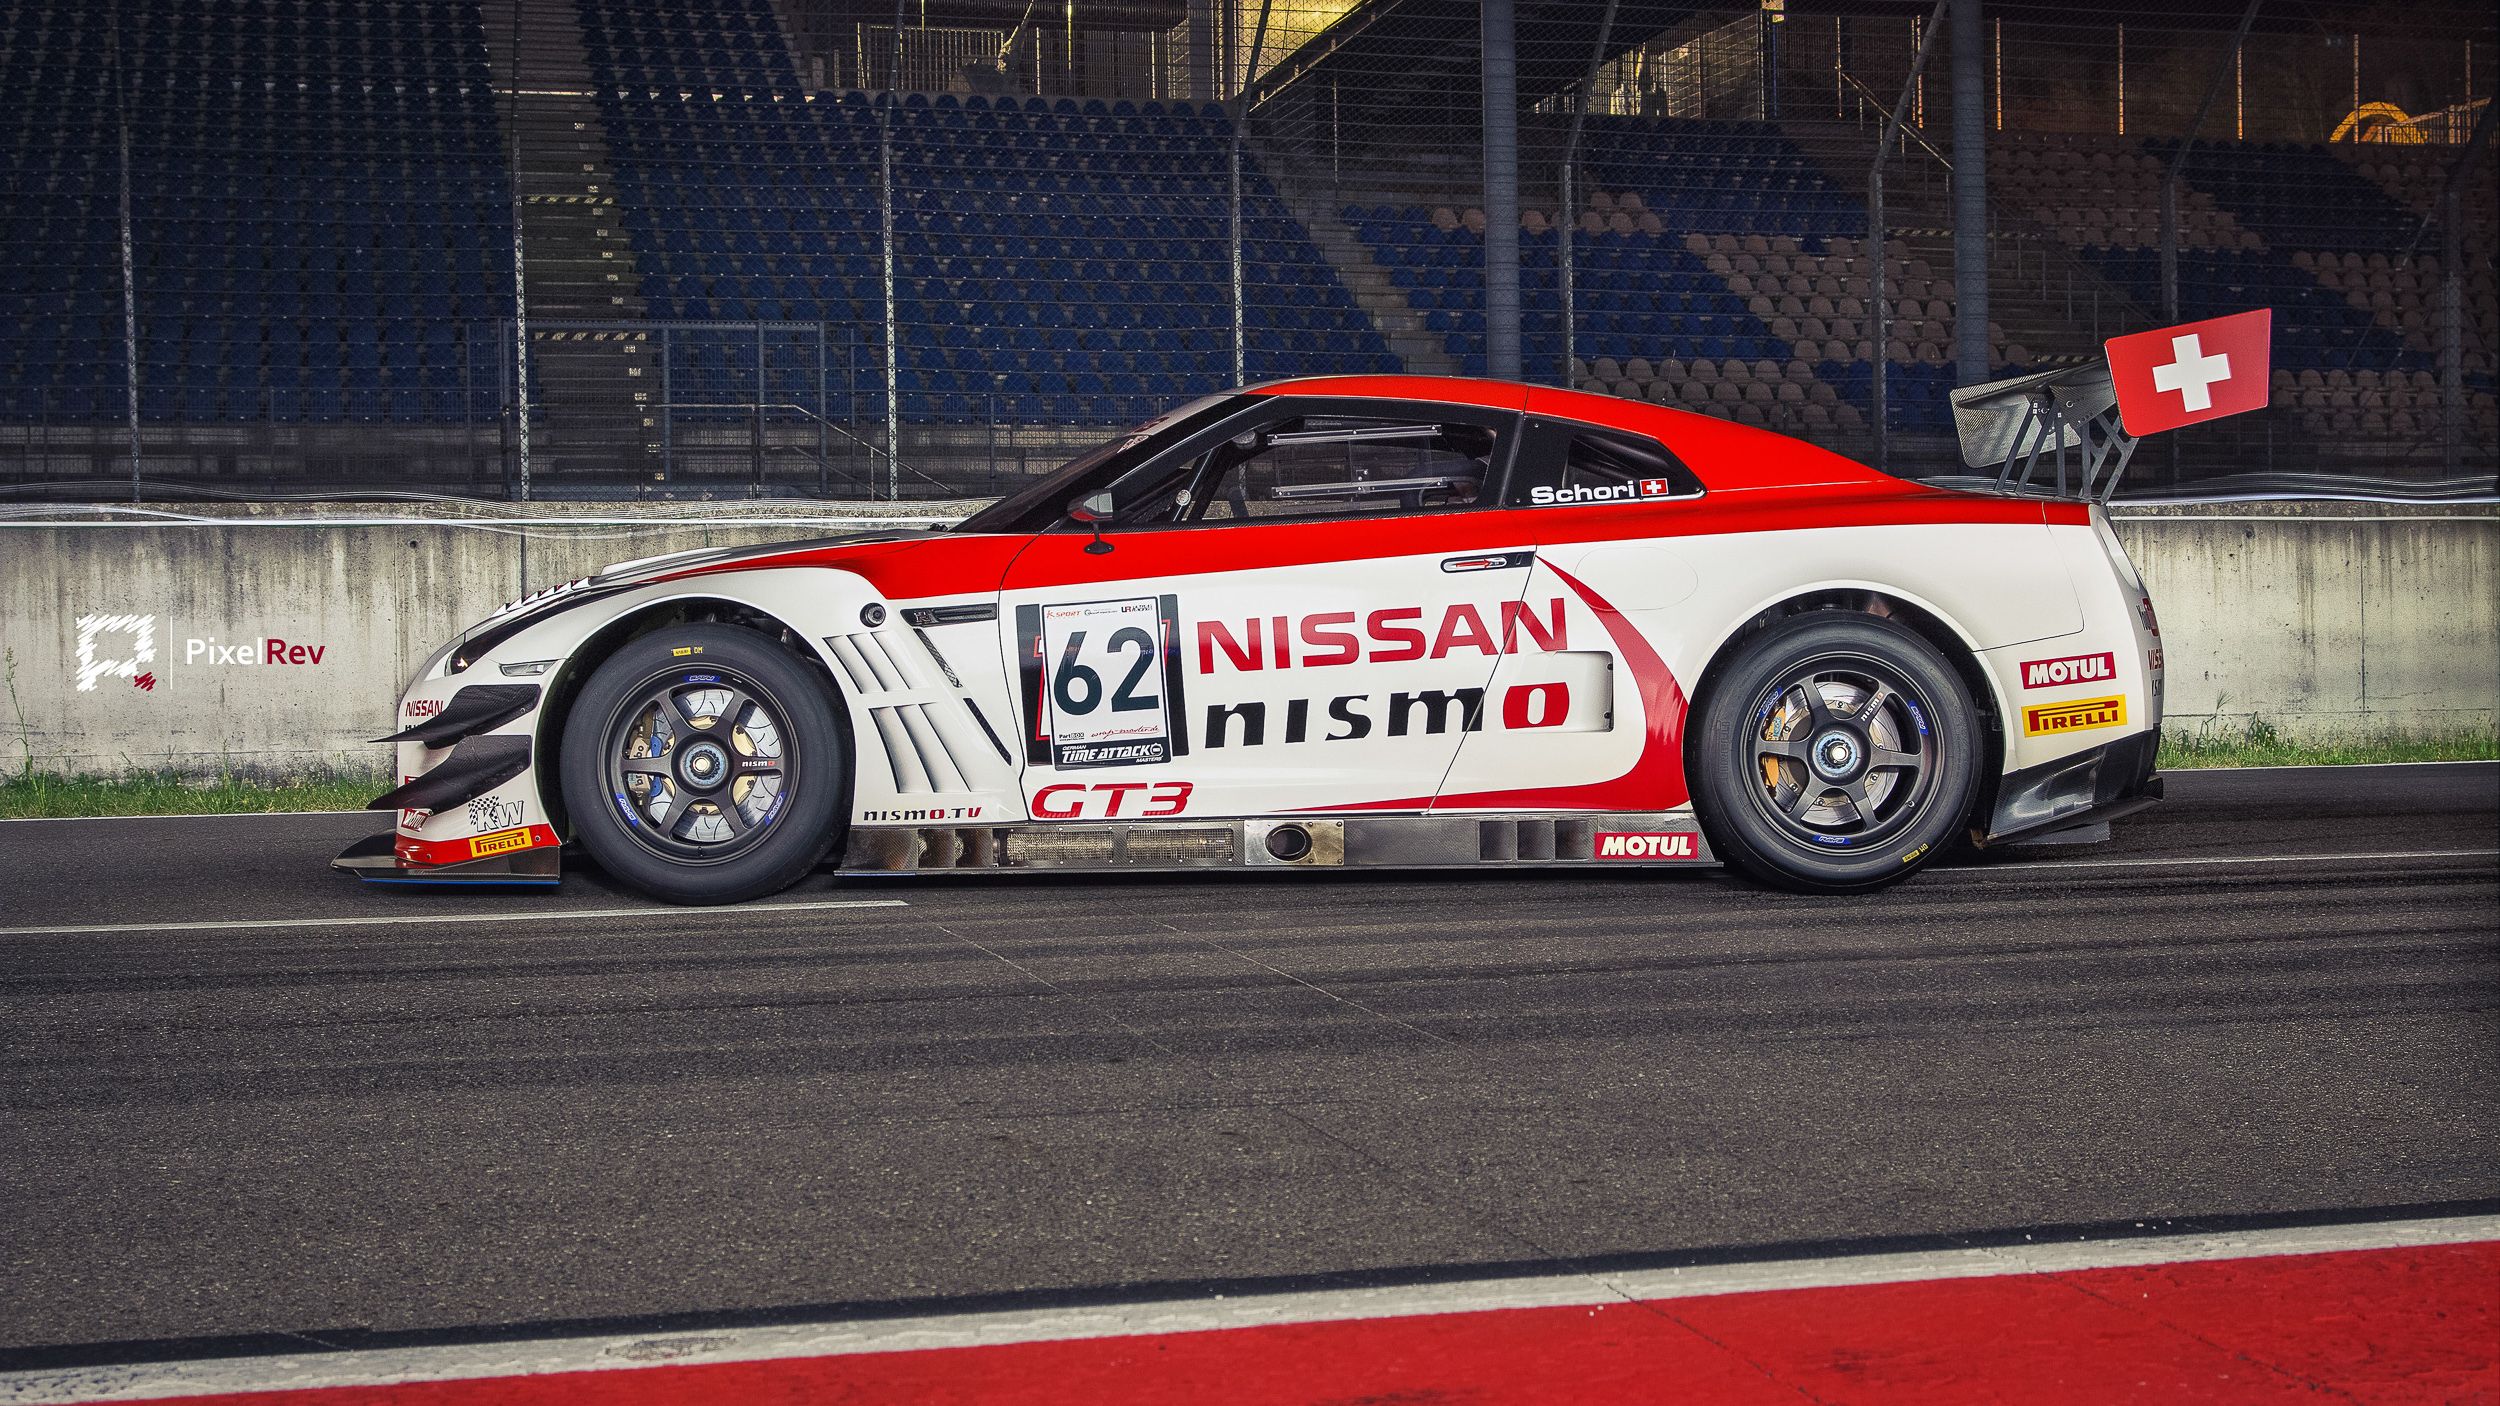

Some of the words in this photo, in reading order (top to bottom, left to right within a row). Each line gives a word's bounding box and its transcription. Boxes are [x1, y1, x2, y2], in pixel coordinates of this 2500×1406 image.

[1531, 480, 1635, 504] Schori
[1197, 598, 1567, 674] NISSAN
[1052, 626, 1160, 716] 62
[2028, 656, 2110, 685] MOTUL
[405, 700, 443, 717] NISSAN
[2028, 700, 2119, 732] PIRELLI
[1099, 746, 1150, 759] ATTACK
[1031, 782, 1194, 818] GT3
[476, 800, 524, 832] KW
[475, 832, 526, 853] PIRELLI
[1601, 835, 1692, 856] MOTUL
